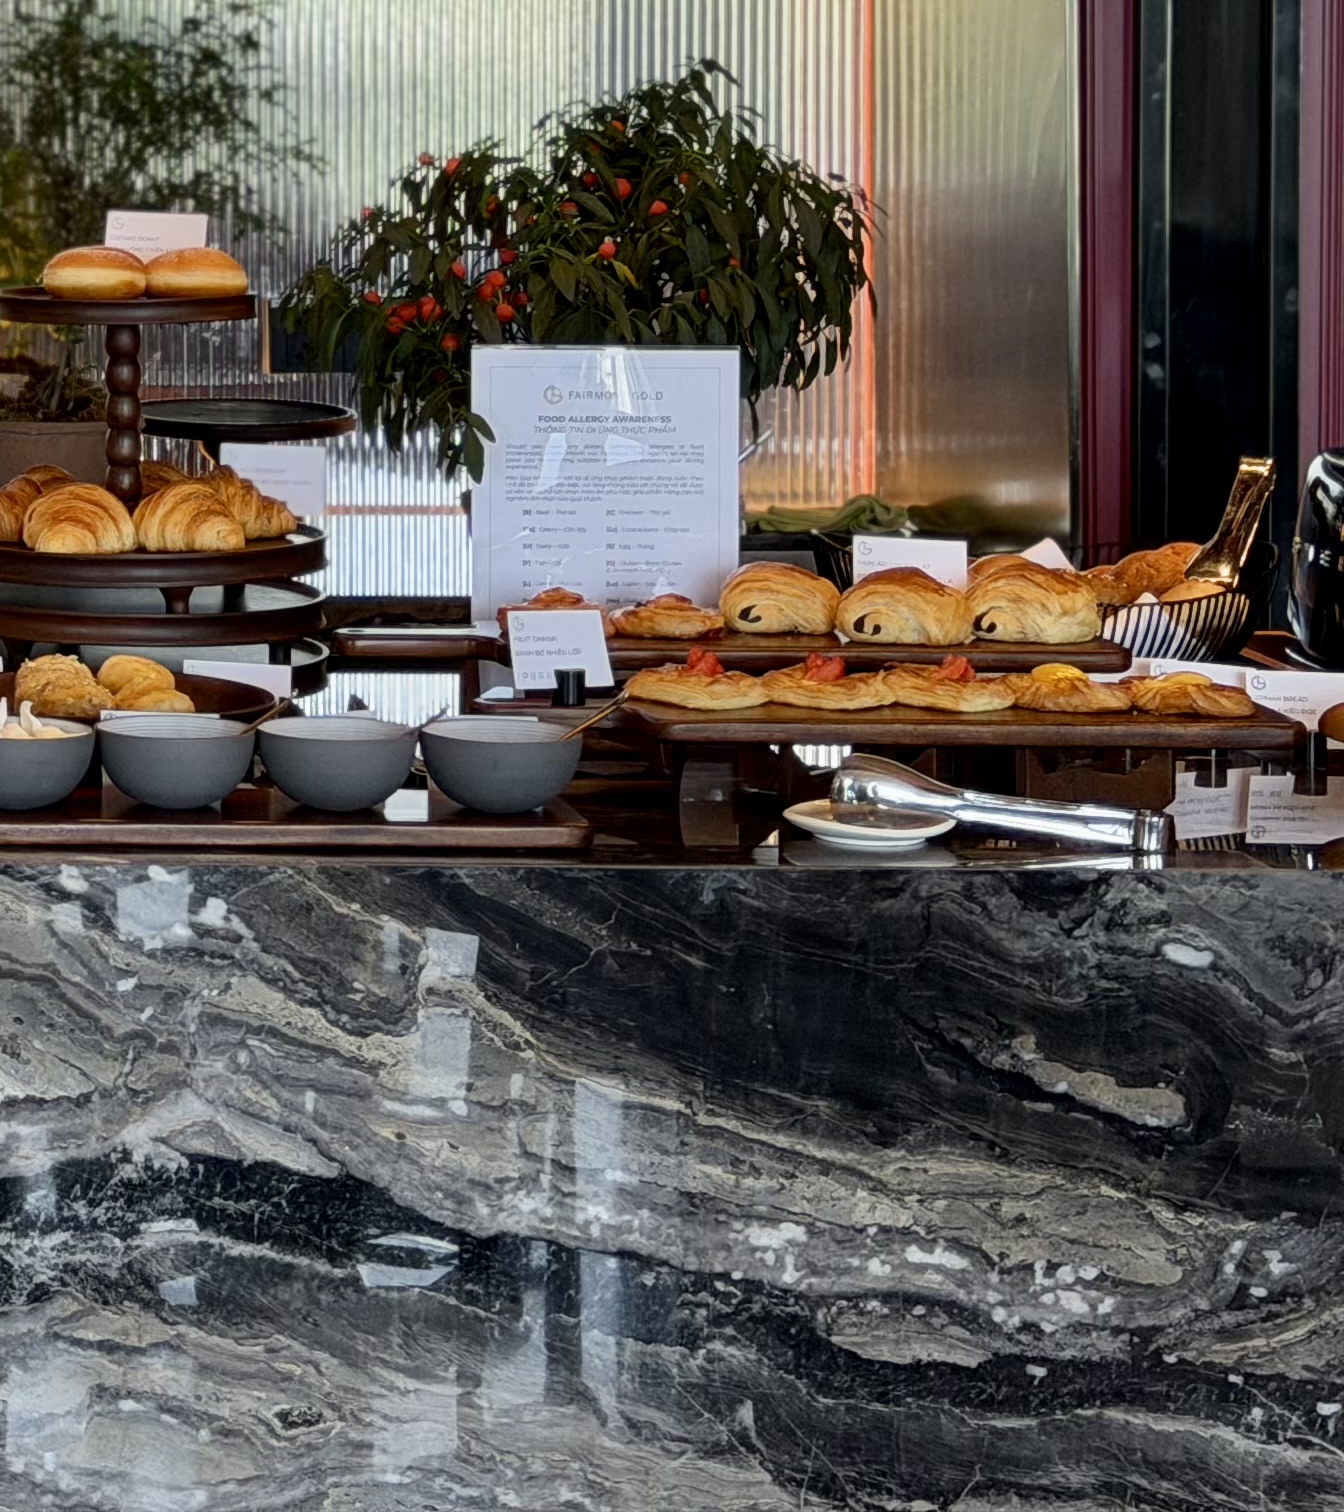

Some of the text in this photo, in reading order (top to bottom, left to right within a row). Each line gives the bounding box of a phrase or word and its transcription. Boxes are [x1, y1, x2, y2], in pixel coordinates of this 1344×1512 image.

[632, 391, 664, 400] GOLD
[538, 415, 672, 423] FOOD ALLERGY AWARENESS
